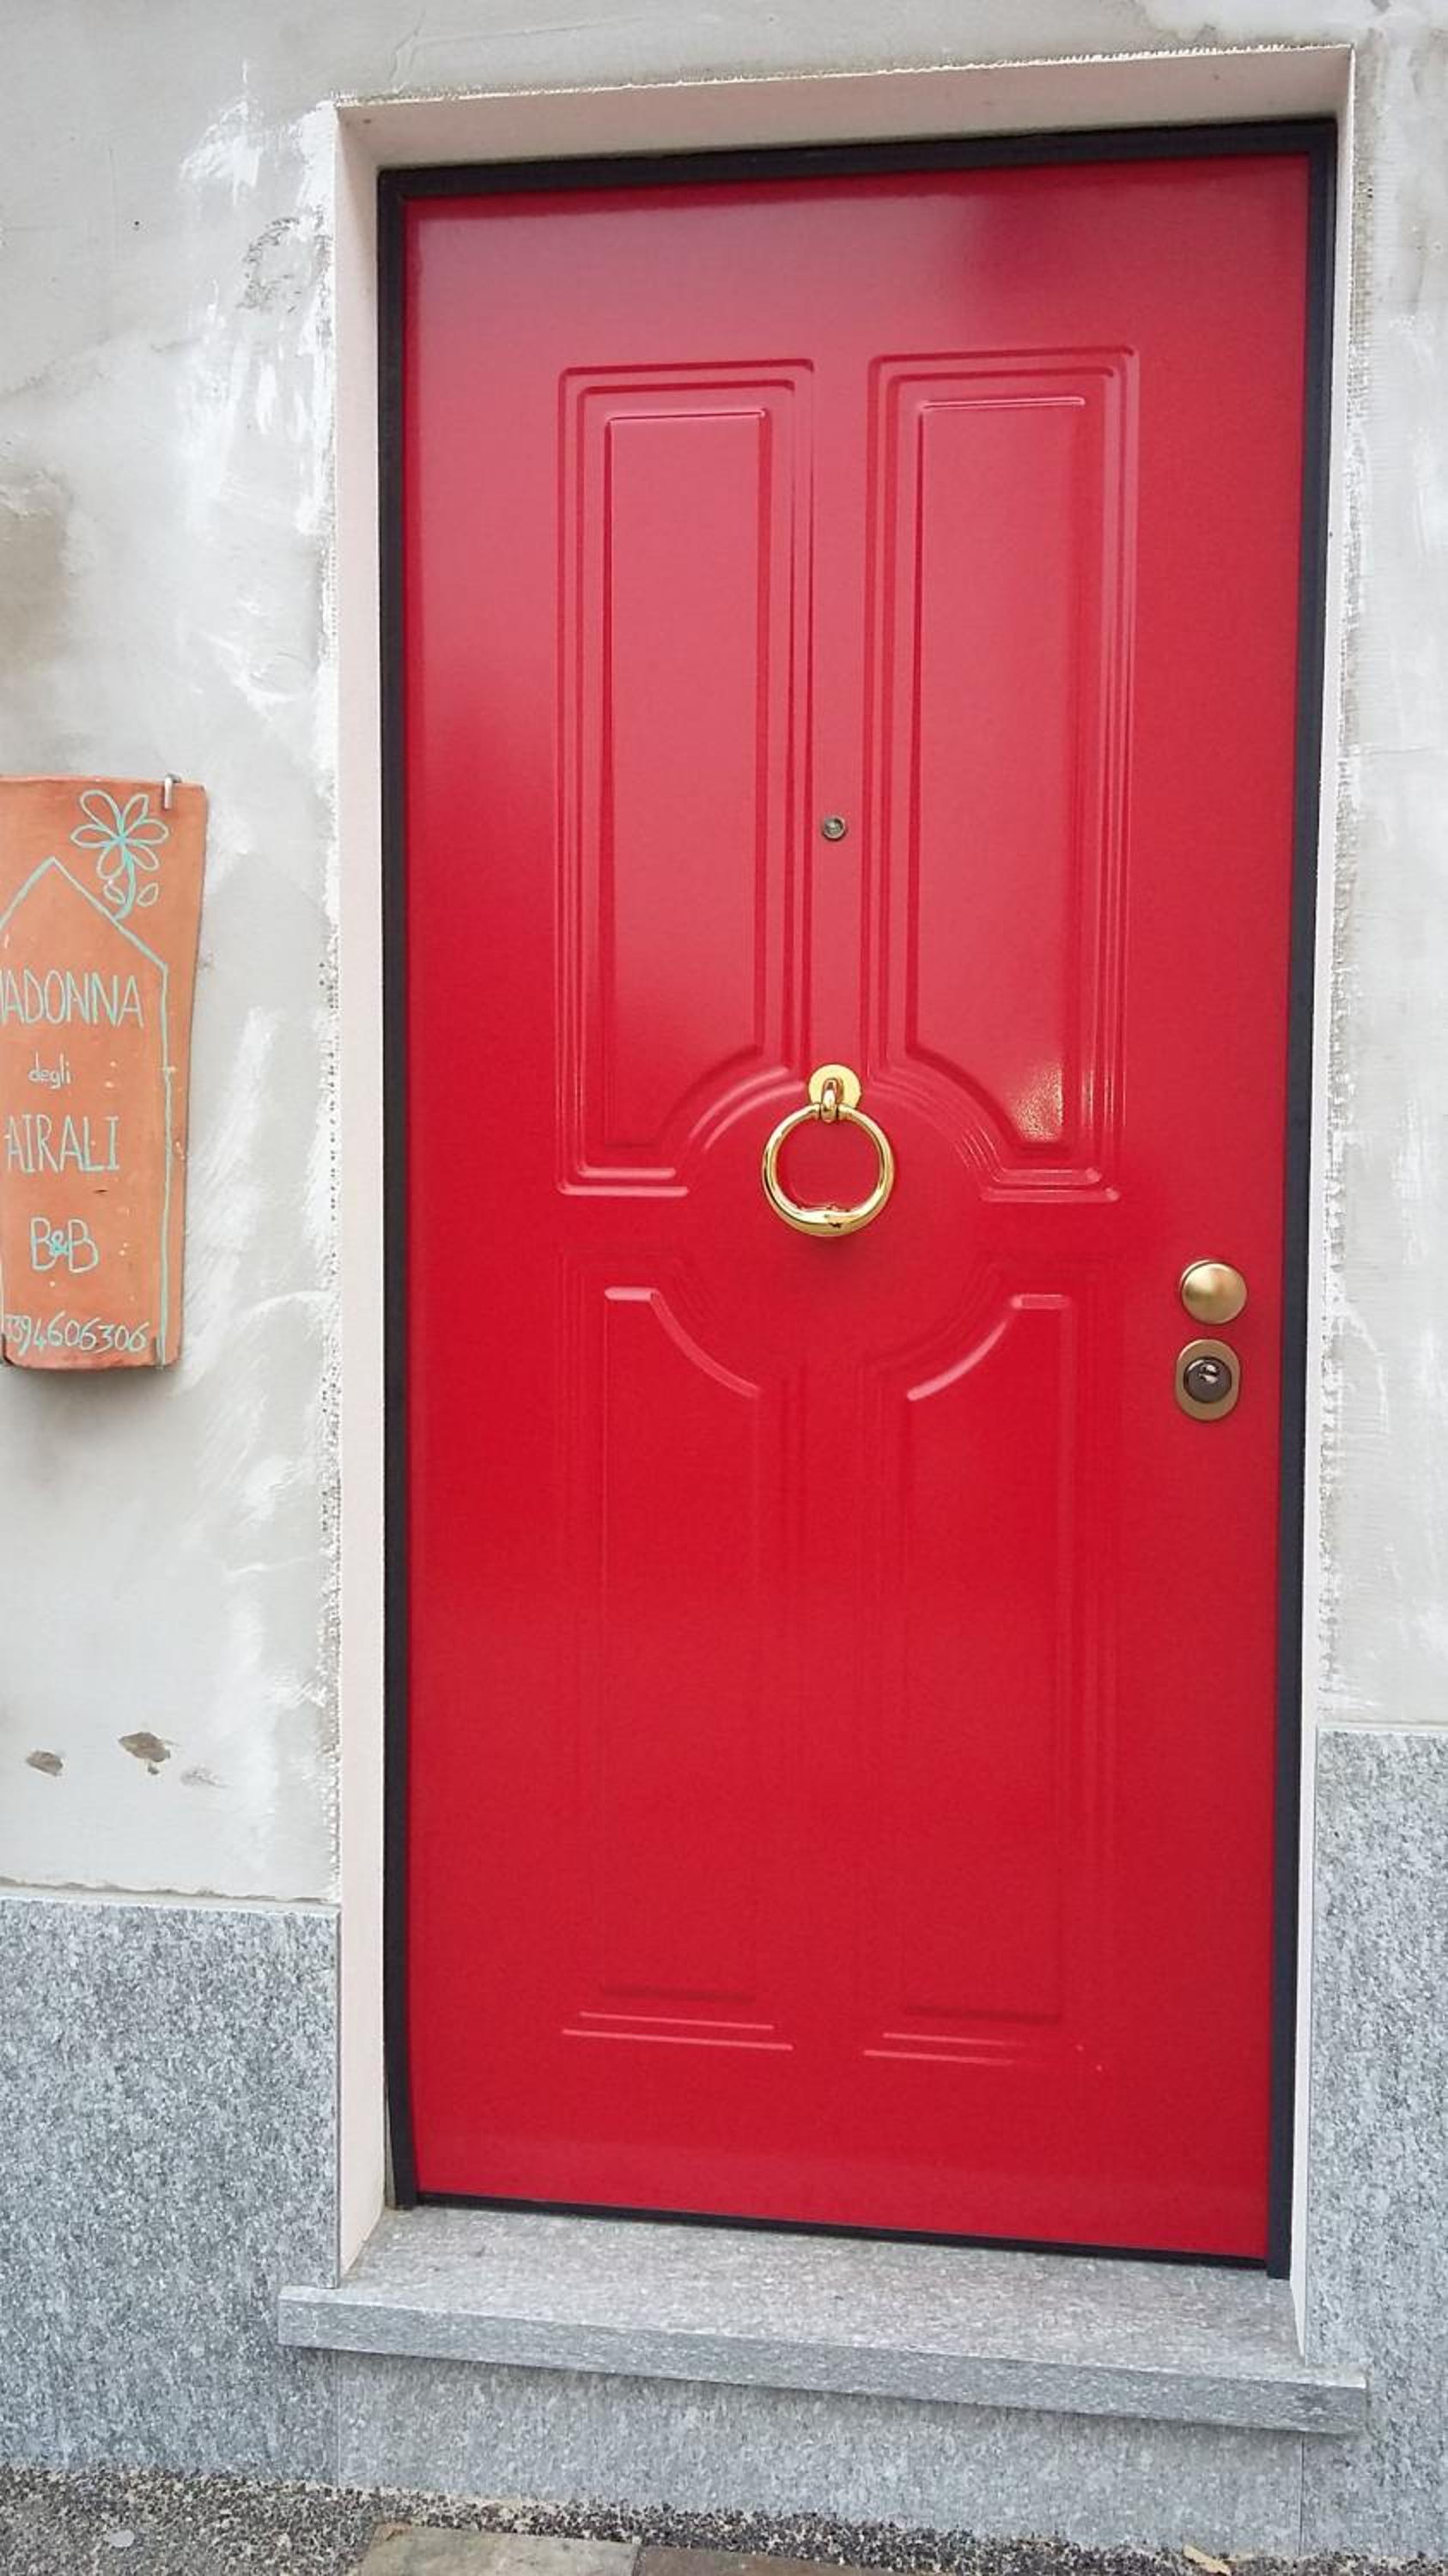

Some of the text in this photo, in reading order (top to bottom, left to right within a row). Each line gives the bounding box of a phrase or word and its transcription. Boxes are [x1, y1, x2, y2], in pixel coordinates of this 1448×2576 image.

[0, 969, 144, 1029] ADONNA
[27, 1050, 71, 1089] degli
[5, 1115, 119, 1173] AIRALI
[30, 1217, 99, 1273] B&B
